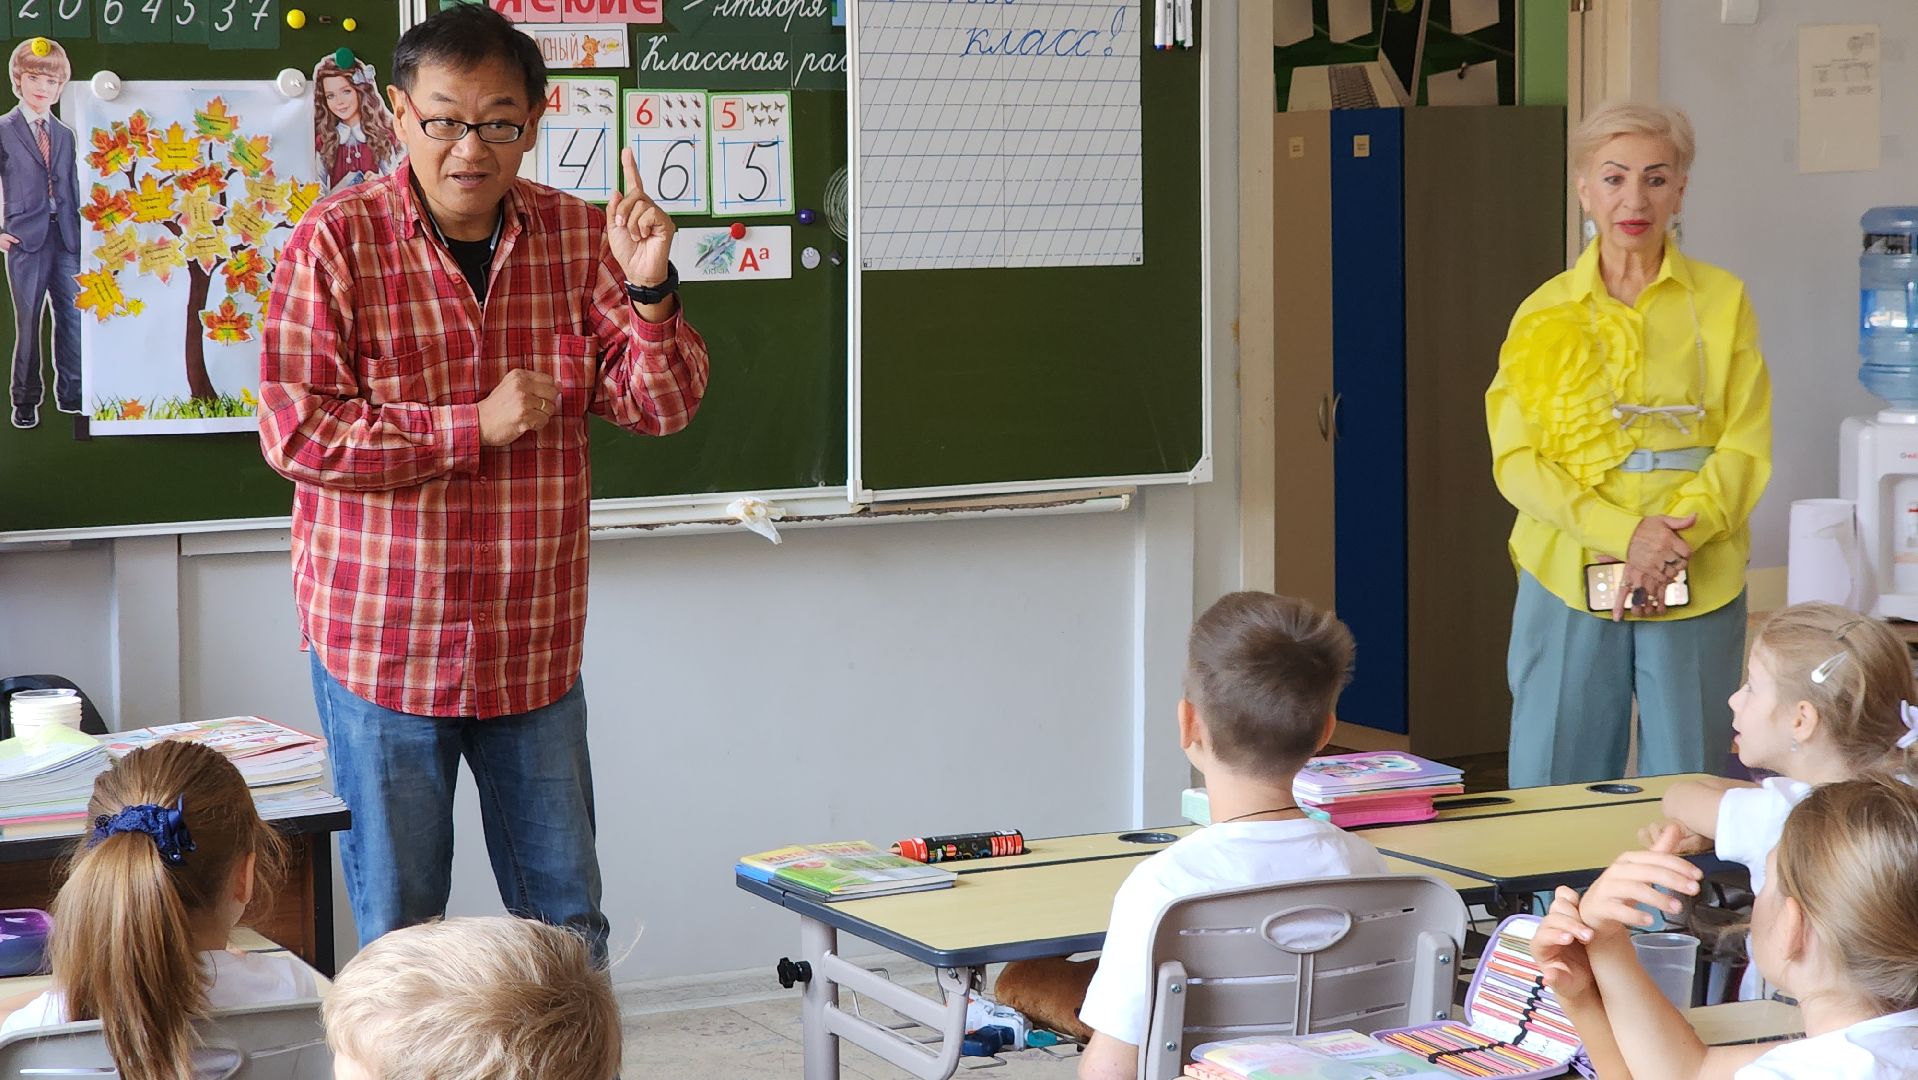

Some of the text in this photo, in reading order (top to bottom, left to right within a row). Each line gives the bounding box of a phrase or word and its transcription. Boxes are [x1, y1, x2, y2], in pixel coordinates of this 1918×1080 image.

[641, 35, 789, 71] Классная
[545, 84, 562, 113] 4
[636, 97, 653, 126] 6
[721, 101, 738, 130] 5
[558, 127, 606, 190] 4
[657, 139, 697, 201] 6
[737, 140, 780, 202] 5
